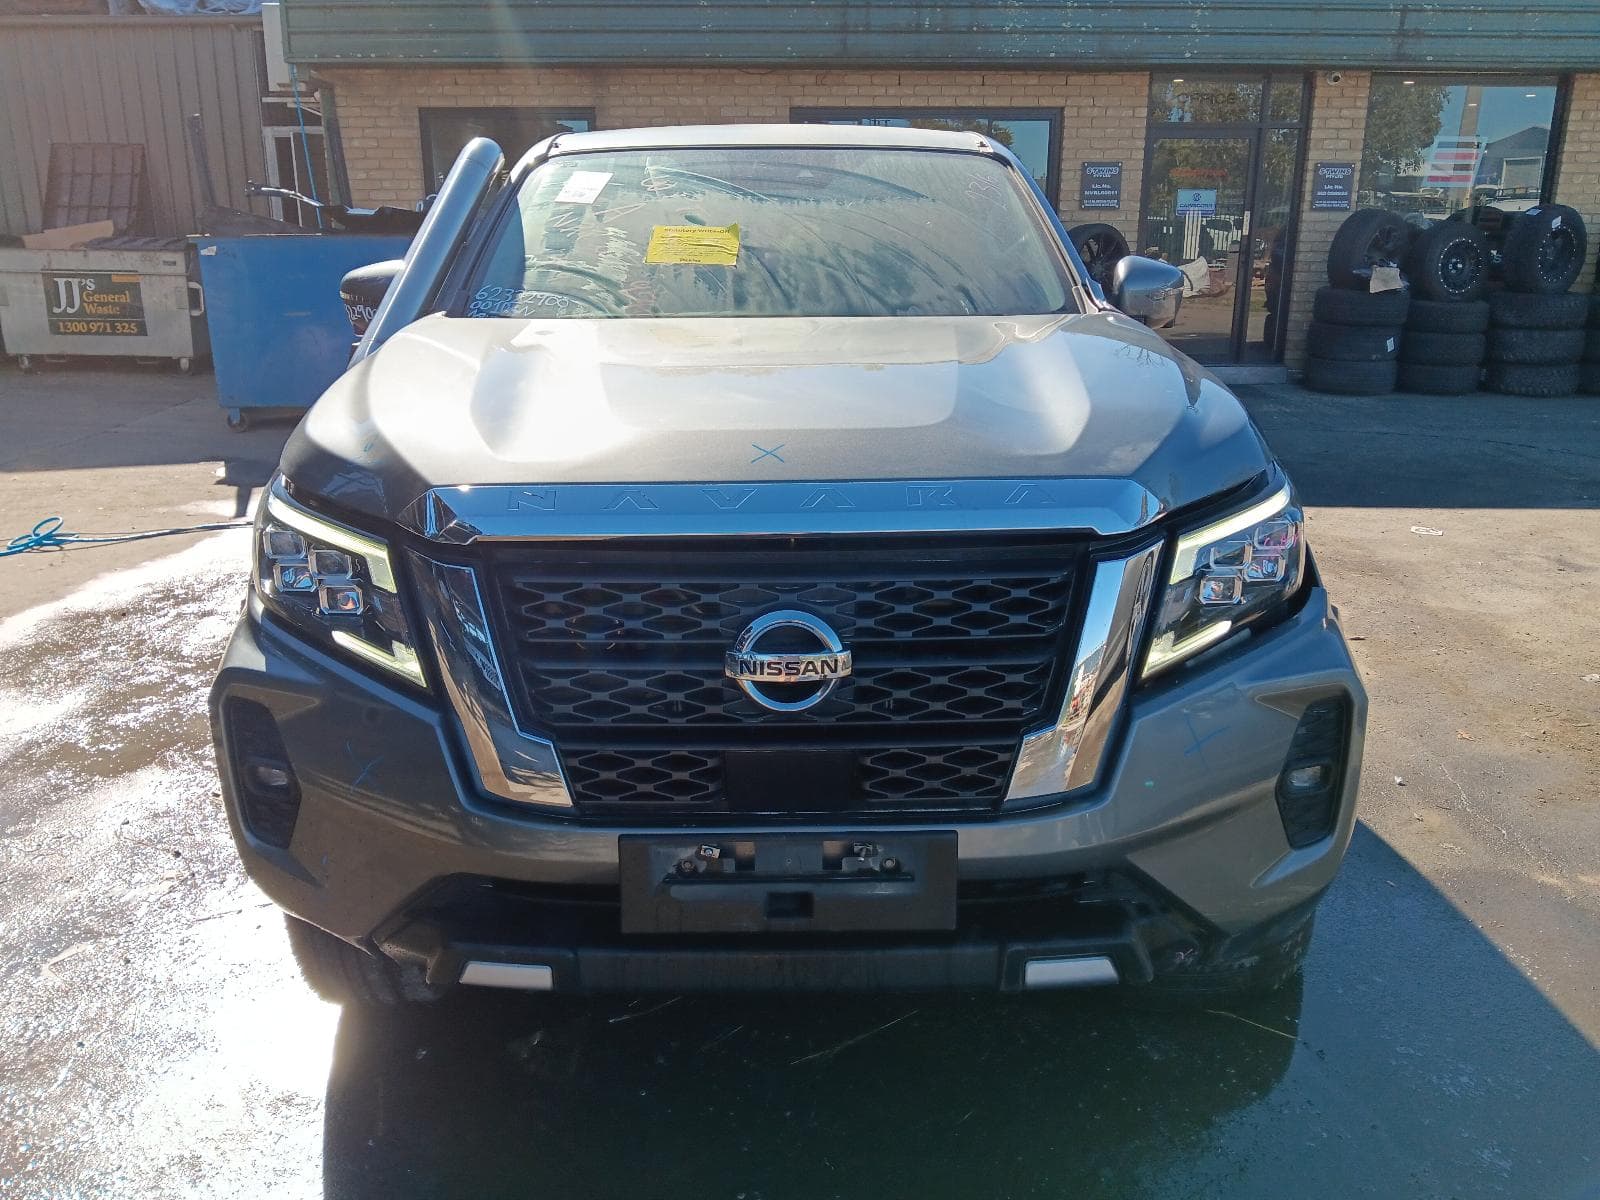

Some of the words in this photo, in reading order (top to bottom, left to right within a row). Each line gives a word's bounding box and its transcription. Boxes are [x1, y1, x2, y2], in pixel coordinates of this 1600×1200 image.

[82, 290, 131, 303] General
[83, 302, 120, 315] Waste
[59, 321, 88, 333] 1300
[89, 321, 112, 333] 971
[114, 322, 138, 334] 325
[506, 483, 1057, 511] NAVARA
[740, 659, 838, 677] NISSAN
